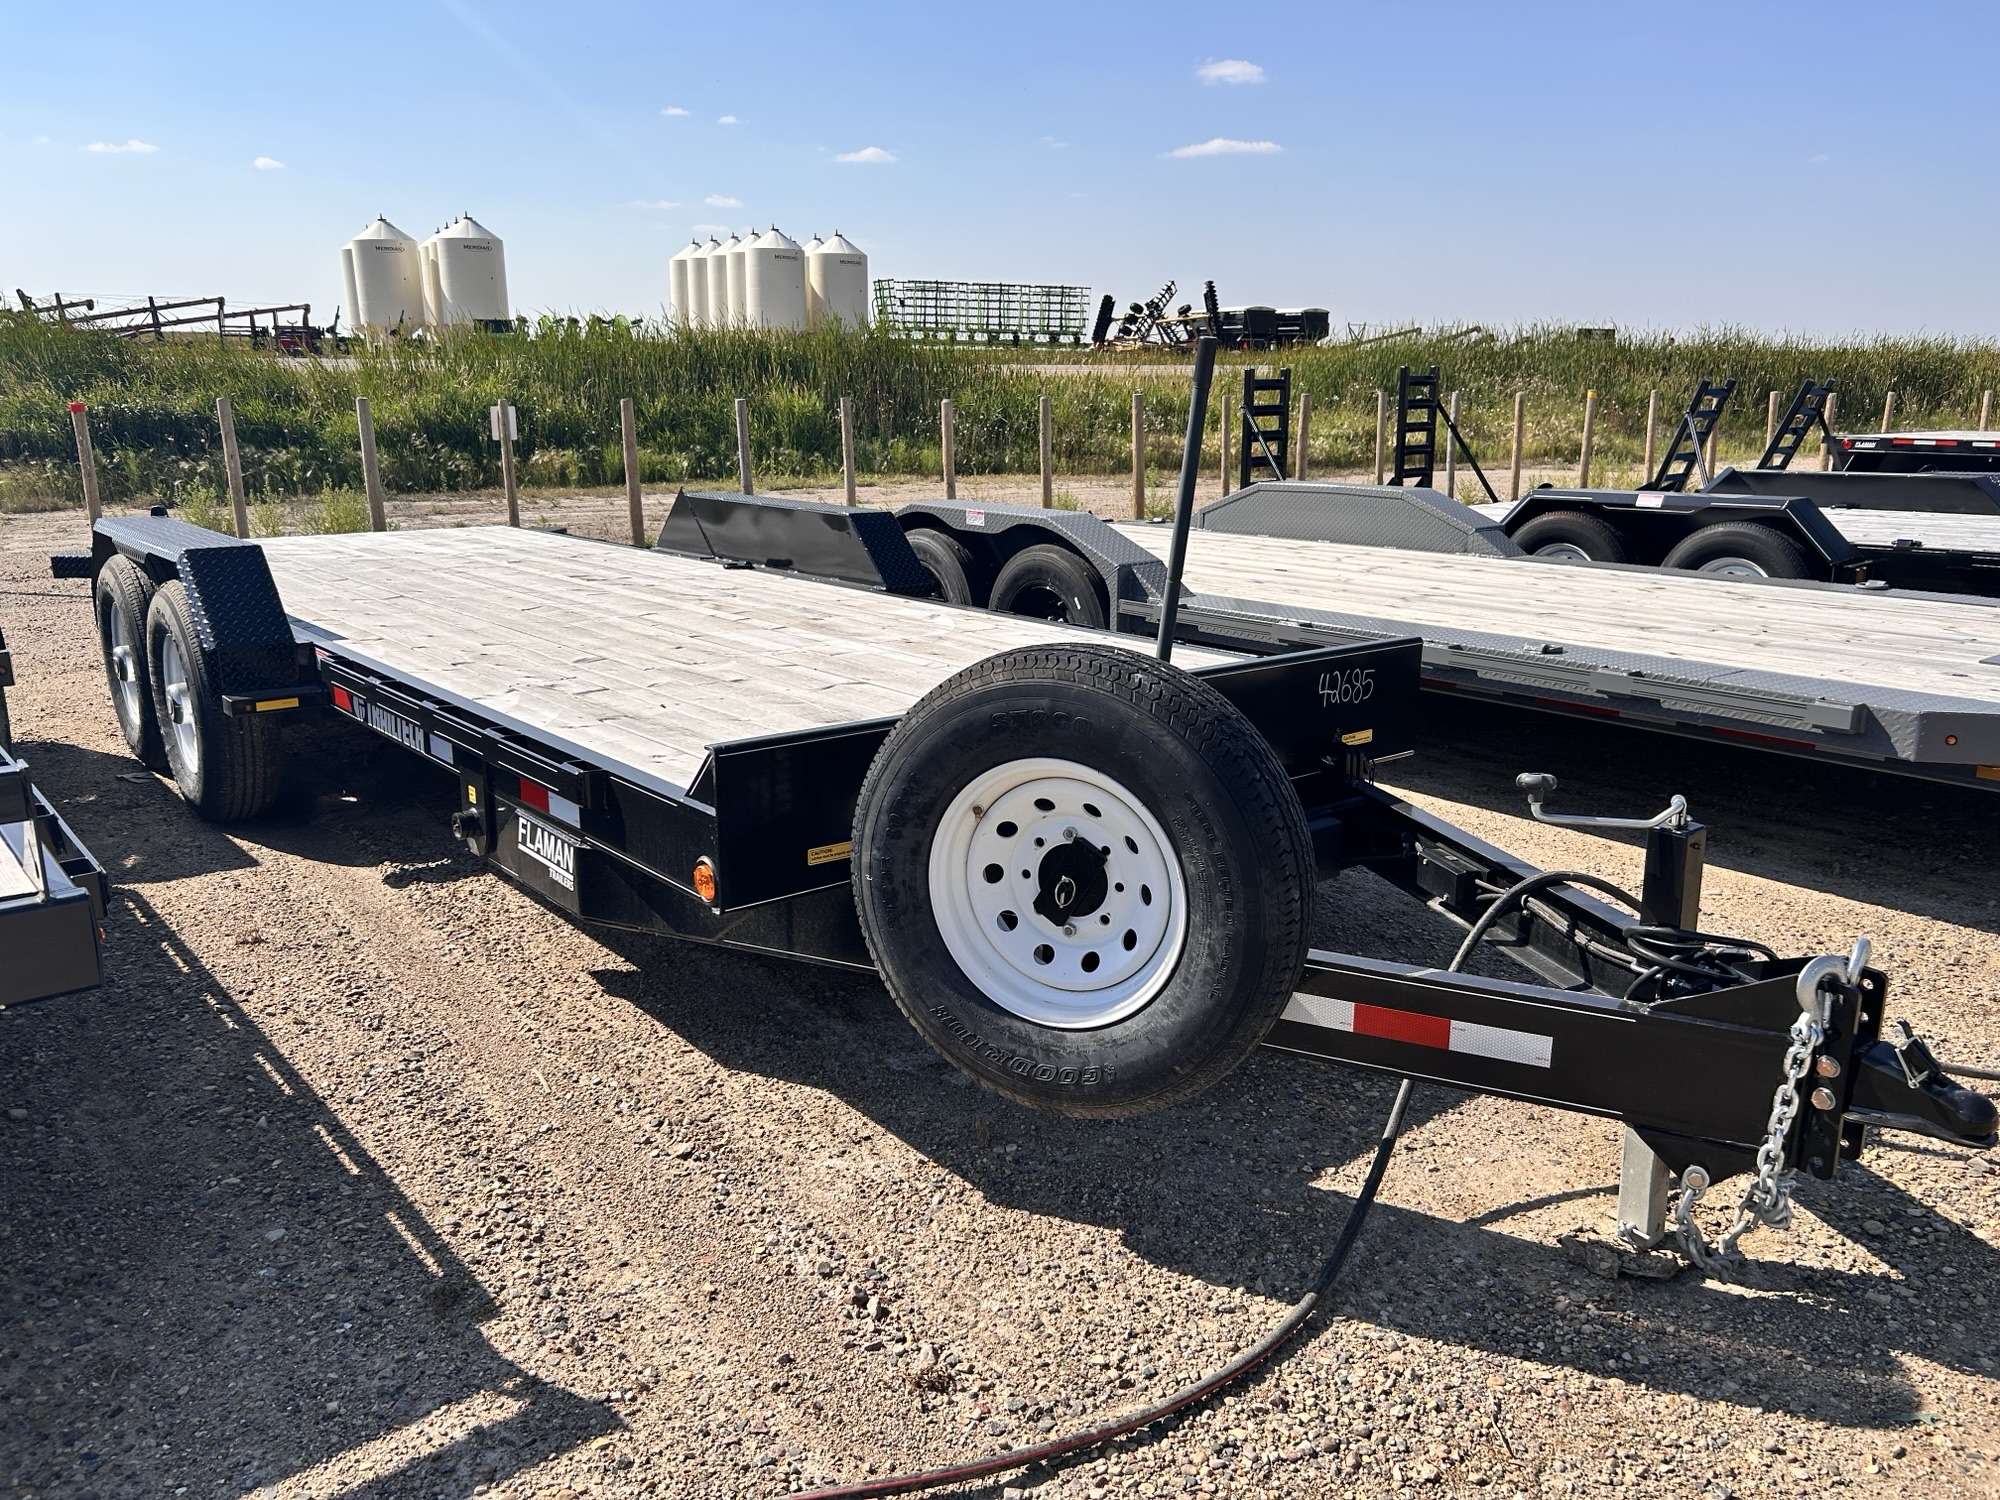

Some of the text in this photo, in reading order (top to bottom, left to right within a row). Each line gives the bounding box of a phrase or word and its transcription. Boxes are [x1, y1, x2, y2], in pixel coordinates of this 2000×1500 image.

[1318, 668, 1376, 708] 42685
[518, 816, 574, 874] FLAMAN
[548, 867, 574, 892] TRAILERS
